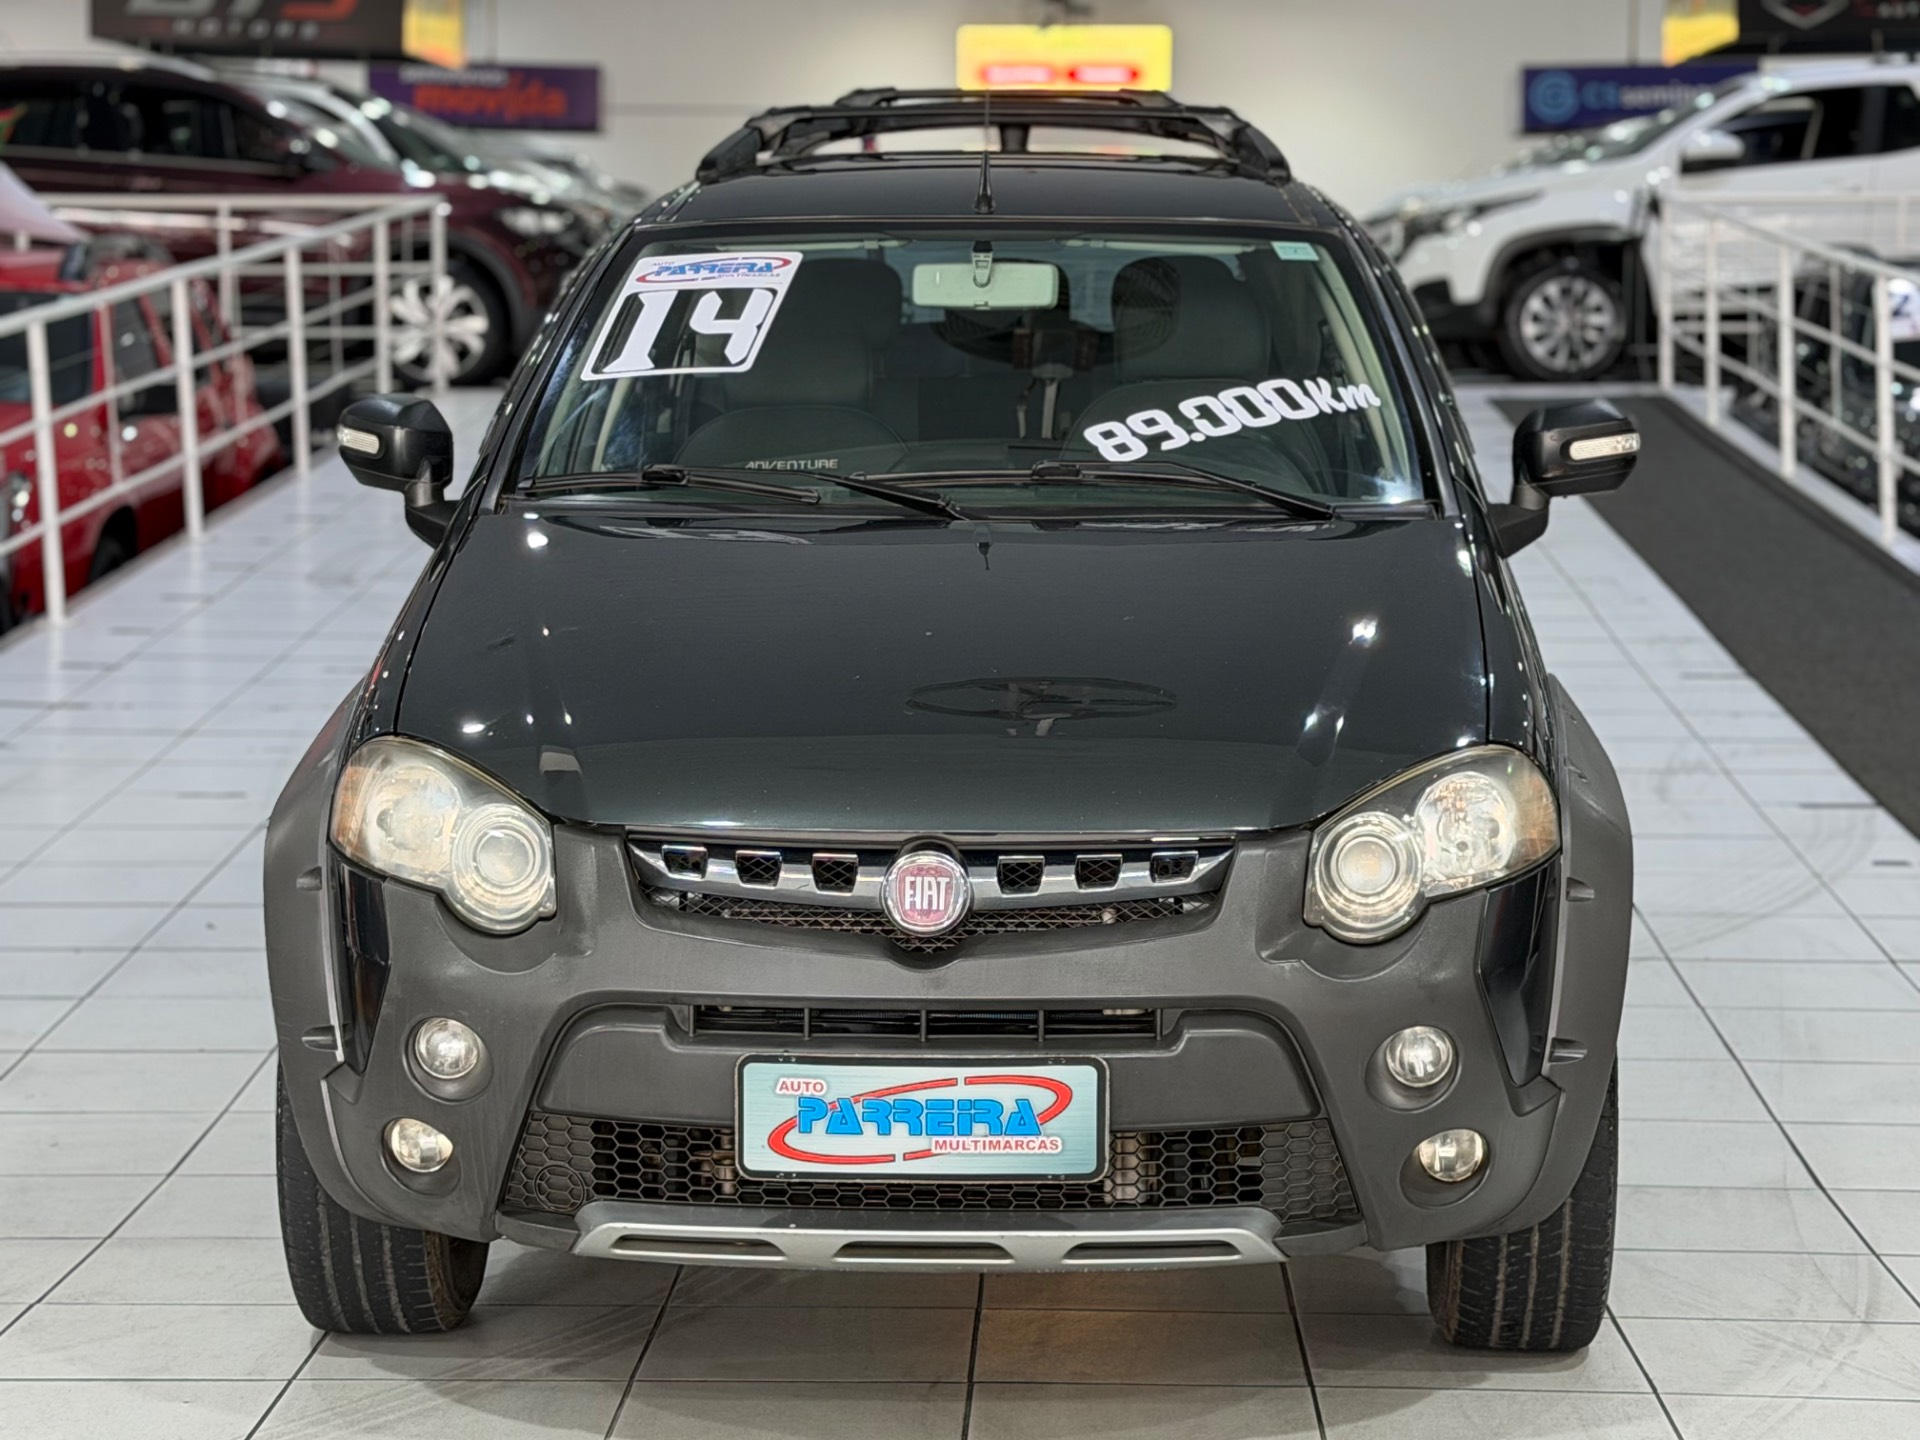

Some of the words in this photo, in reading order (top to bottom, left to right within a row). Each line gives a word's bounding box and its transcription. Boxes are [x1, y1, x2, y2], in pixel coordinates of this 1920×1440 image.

[654, 262, 774, 277] PARREIRA
[602, 288, 774, 373] 14
[745, 459, 839, 470] ADVENTURE
[904, 876, 950, 911] FIAT
[778, 1080, 825, 1093] AUTO
[797, 1096, 1042, 1136] PARREIRA
[934, 1138, 1060, 1152] MULTIMARCAS
